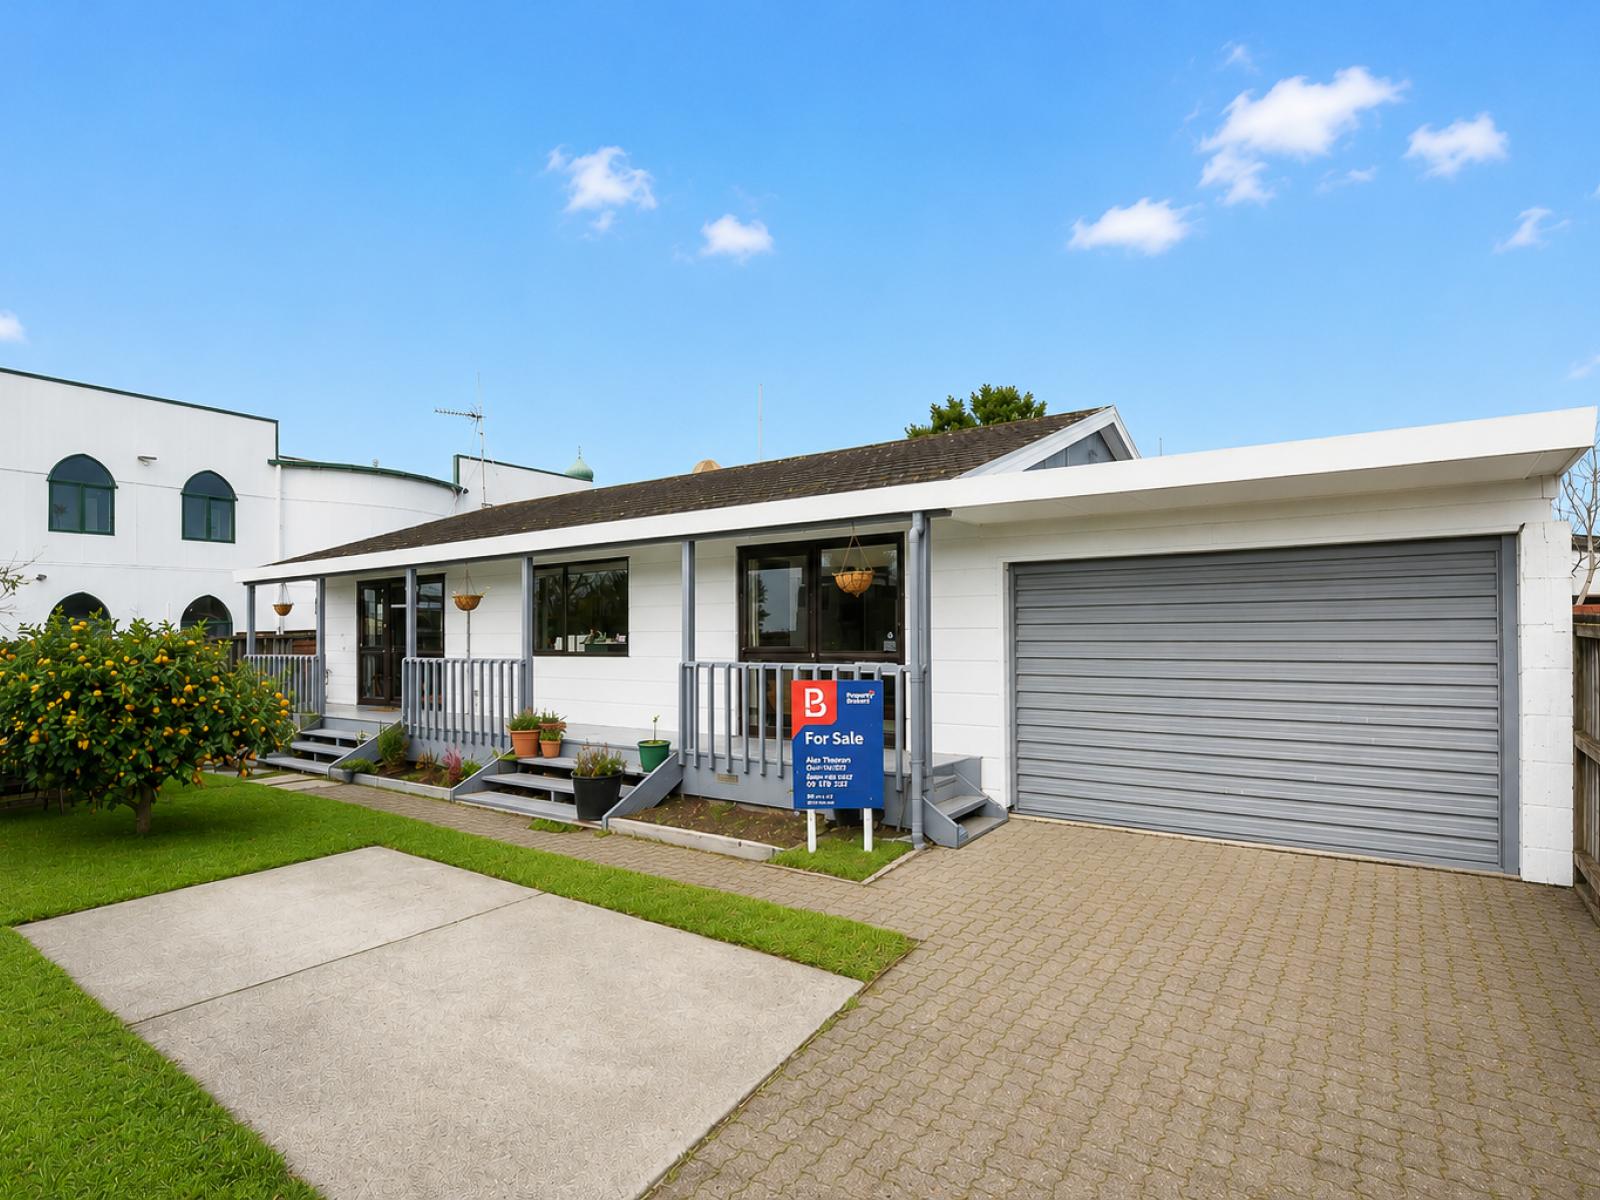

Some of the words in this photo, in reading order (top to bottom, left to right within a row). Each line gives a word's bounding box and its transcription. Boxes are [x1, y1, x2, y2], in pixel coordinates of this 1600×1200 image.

[805, 688, 827, 717] B
[805, 731, 829, 745] For
[832, 731, 864, 745] Sale
